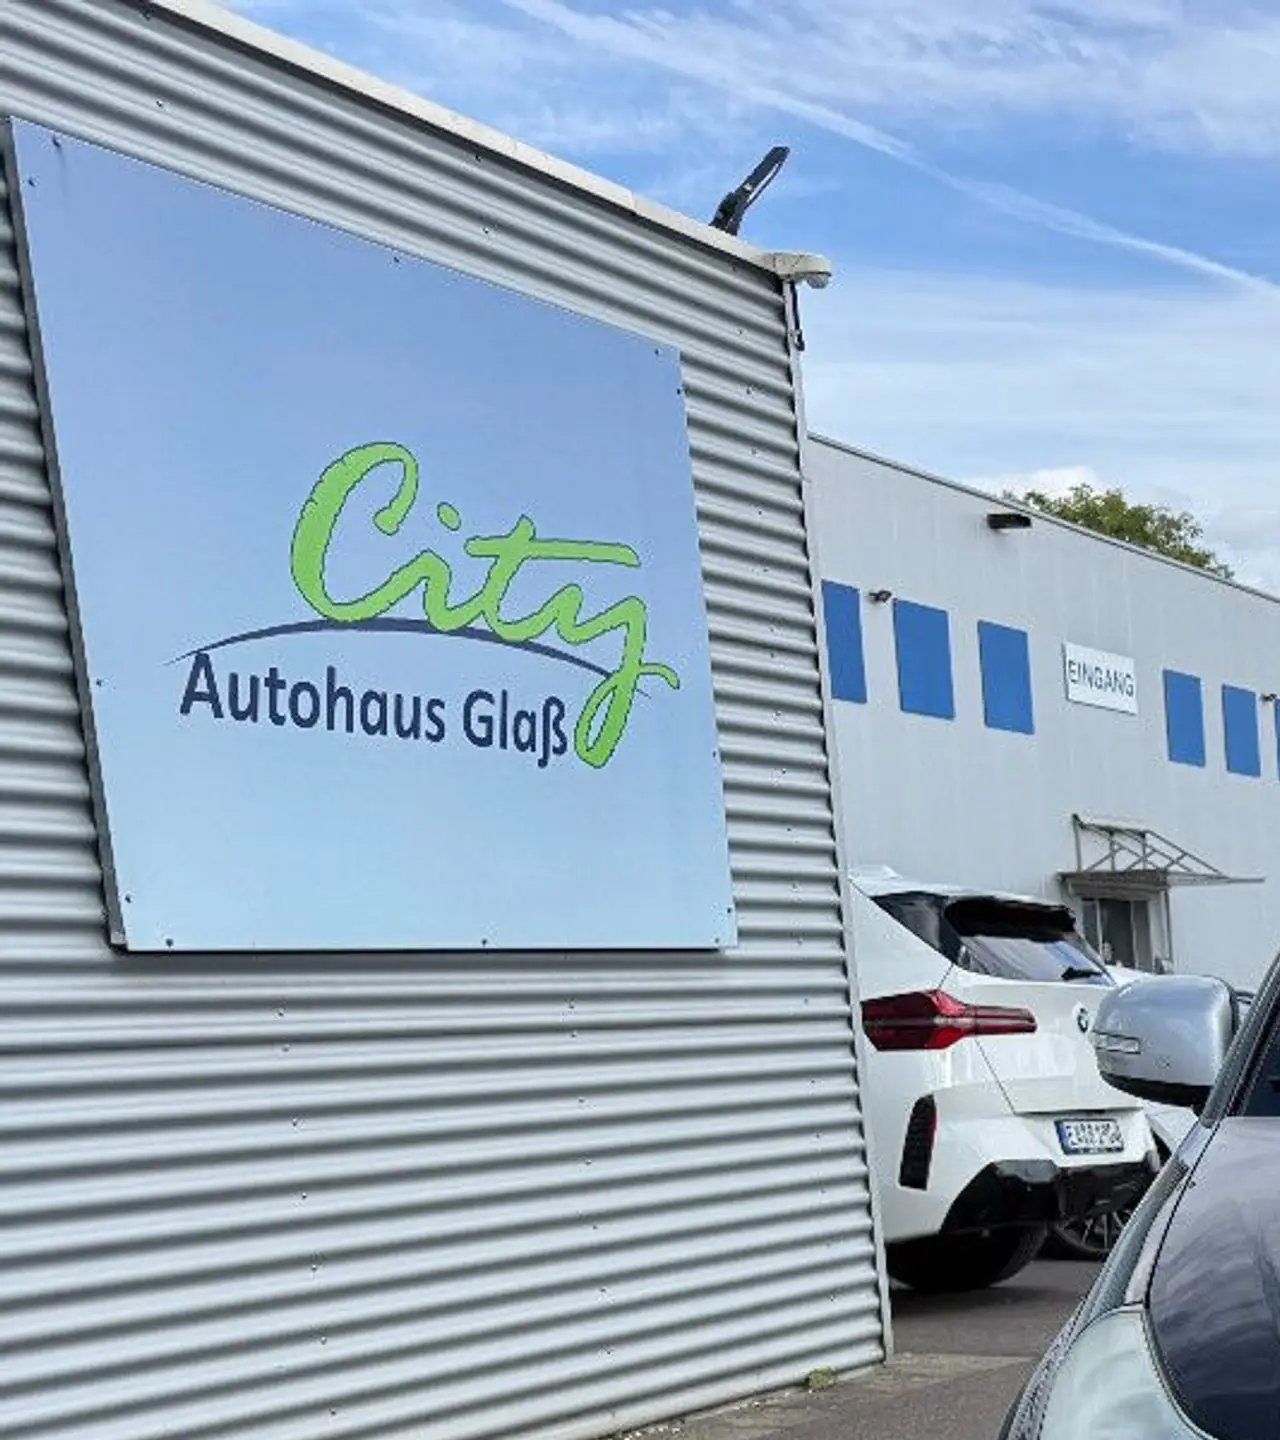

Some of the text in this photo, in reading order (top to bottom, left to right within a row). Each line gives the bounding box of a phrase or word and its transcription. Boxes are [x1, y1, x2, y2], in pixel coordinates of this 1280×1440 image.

[291, 442, 679, 767] City
[180, 653, 568, 768] Autohaus Glaß
[1067, 659, 1134, 698] EINGANG
